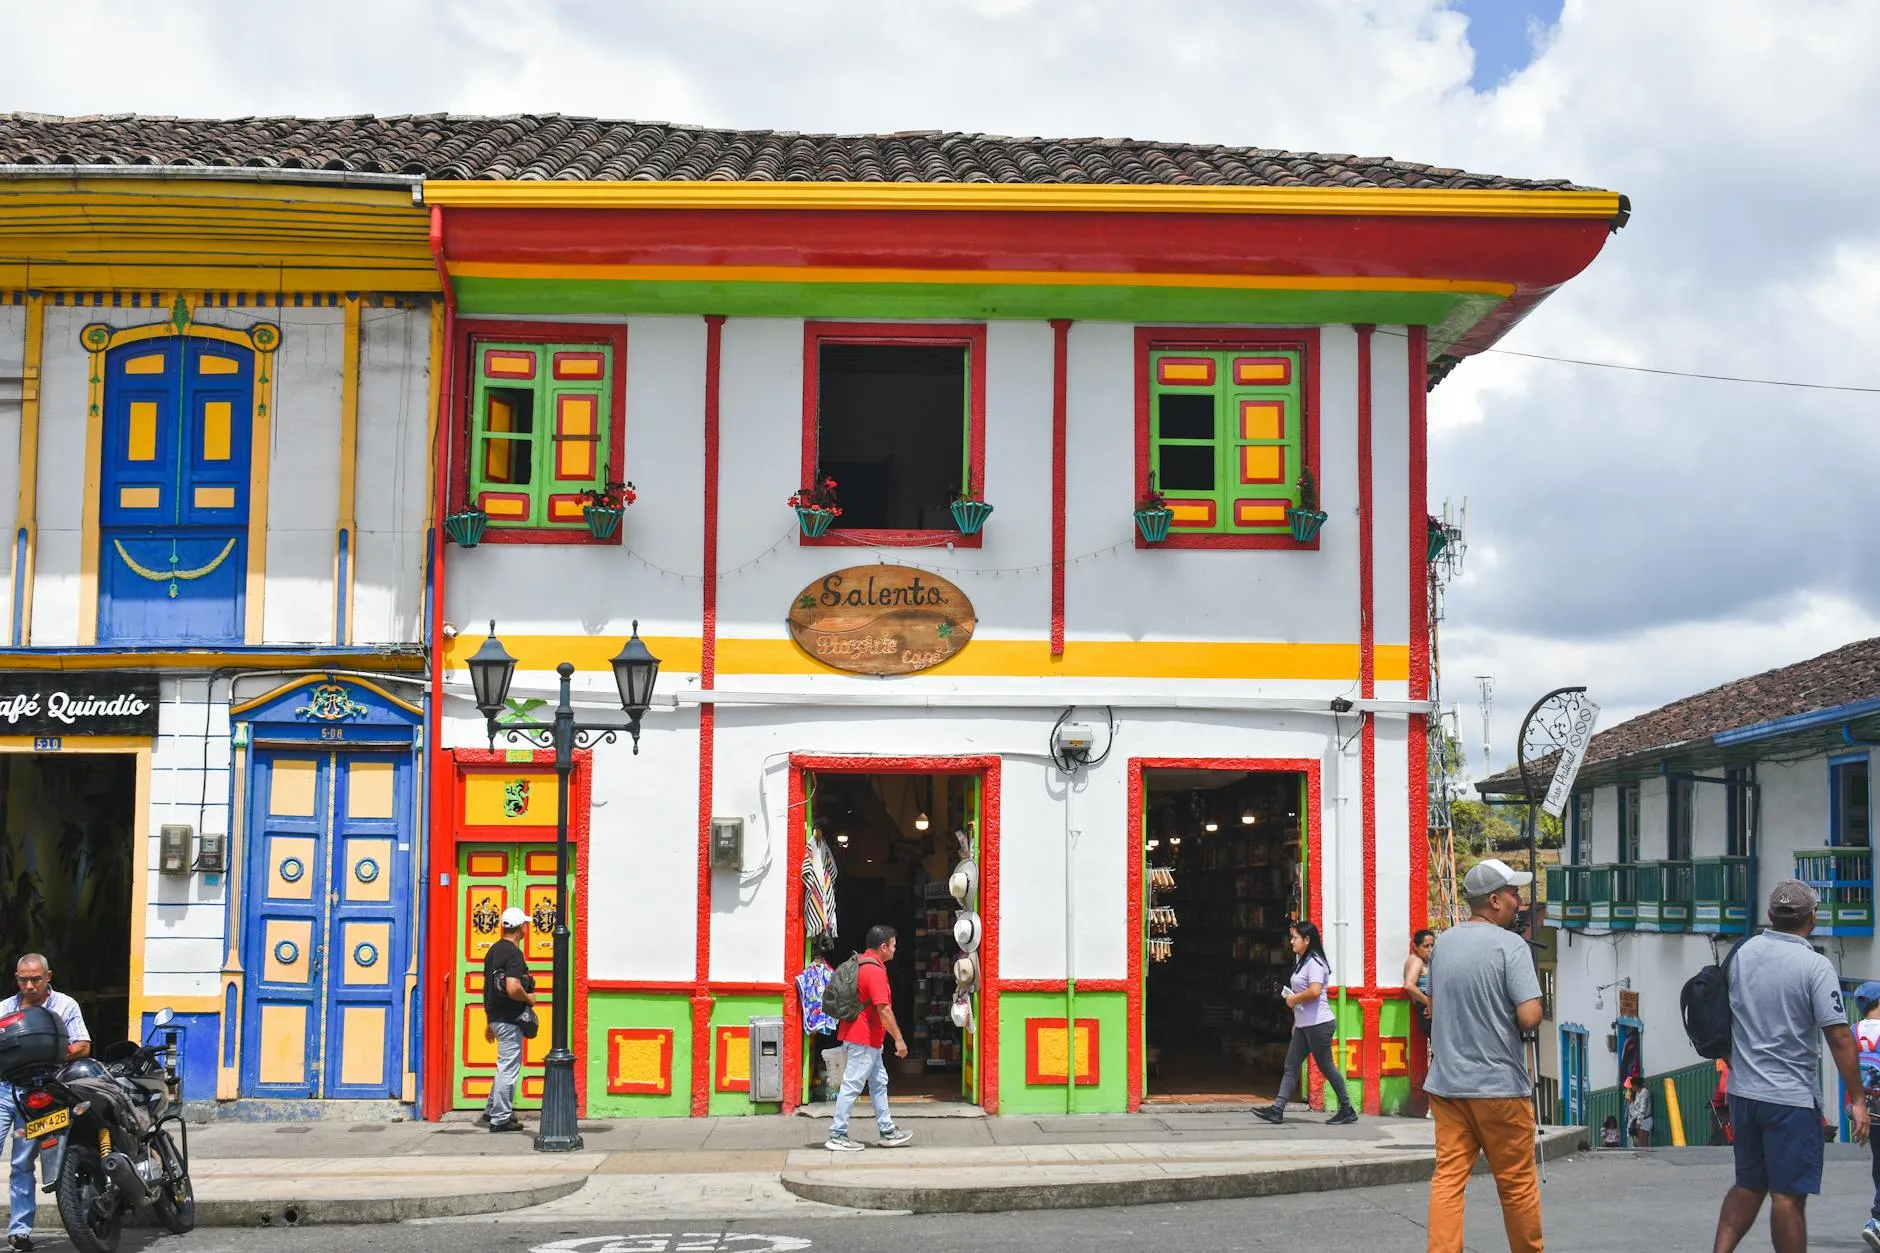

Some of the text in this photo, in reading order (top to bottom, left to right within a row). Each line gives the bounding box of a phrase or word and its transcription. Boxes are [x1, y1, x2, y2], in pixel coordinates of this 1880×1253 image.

[820, 575, 949, 607] Salento
[0, 692, 150, 724] afé Quindío
[36, 738, 58, 749] 5-10
[1831, 991, 1844, 1014] 3
